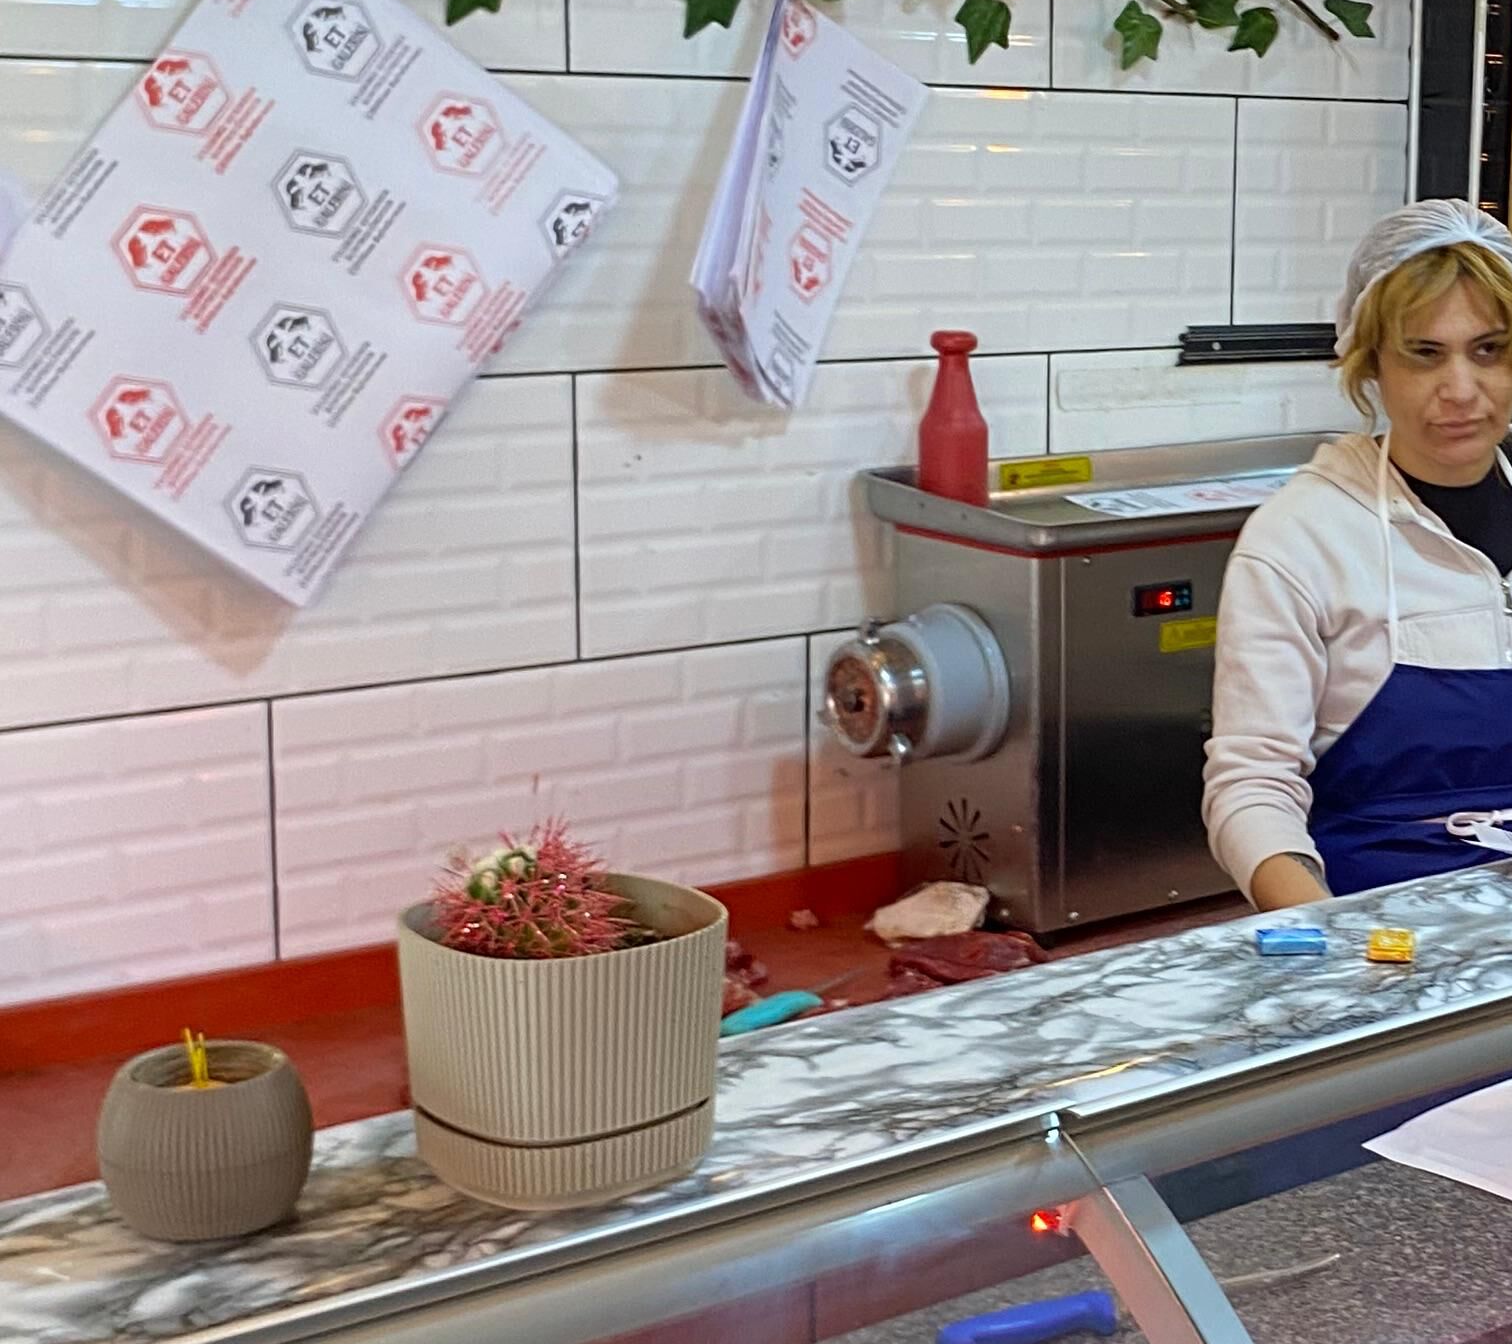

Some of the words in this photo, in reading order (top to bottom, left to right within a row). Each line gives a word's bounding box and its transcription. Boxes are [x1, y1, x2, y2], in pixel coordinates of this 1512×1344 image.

[323, 23, 346, 49] ET
[308, 181, 330, 206] ET
[288, 336, 310, 360] ET
[262, 499, 284, 522] ET
